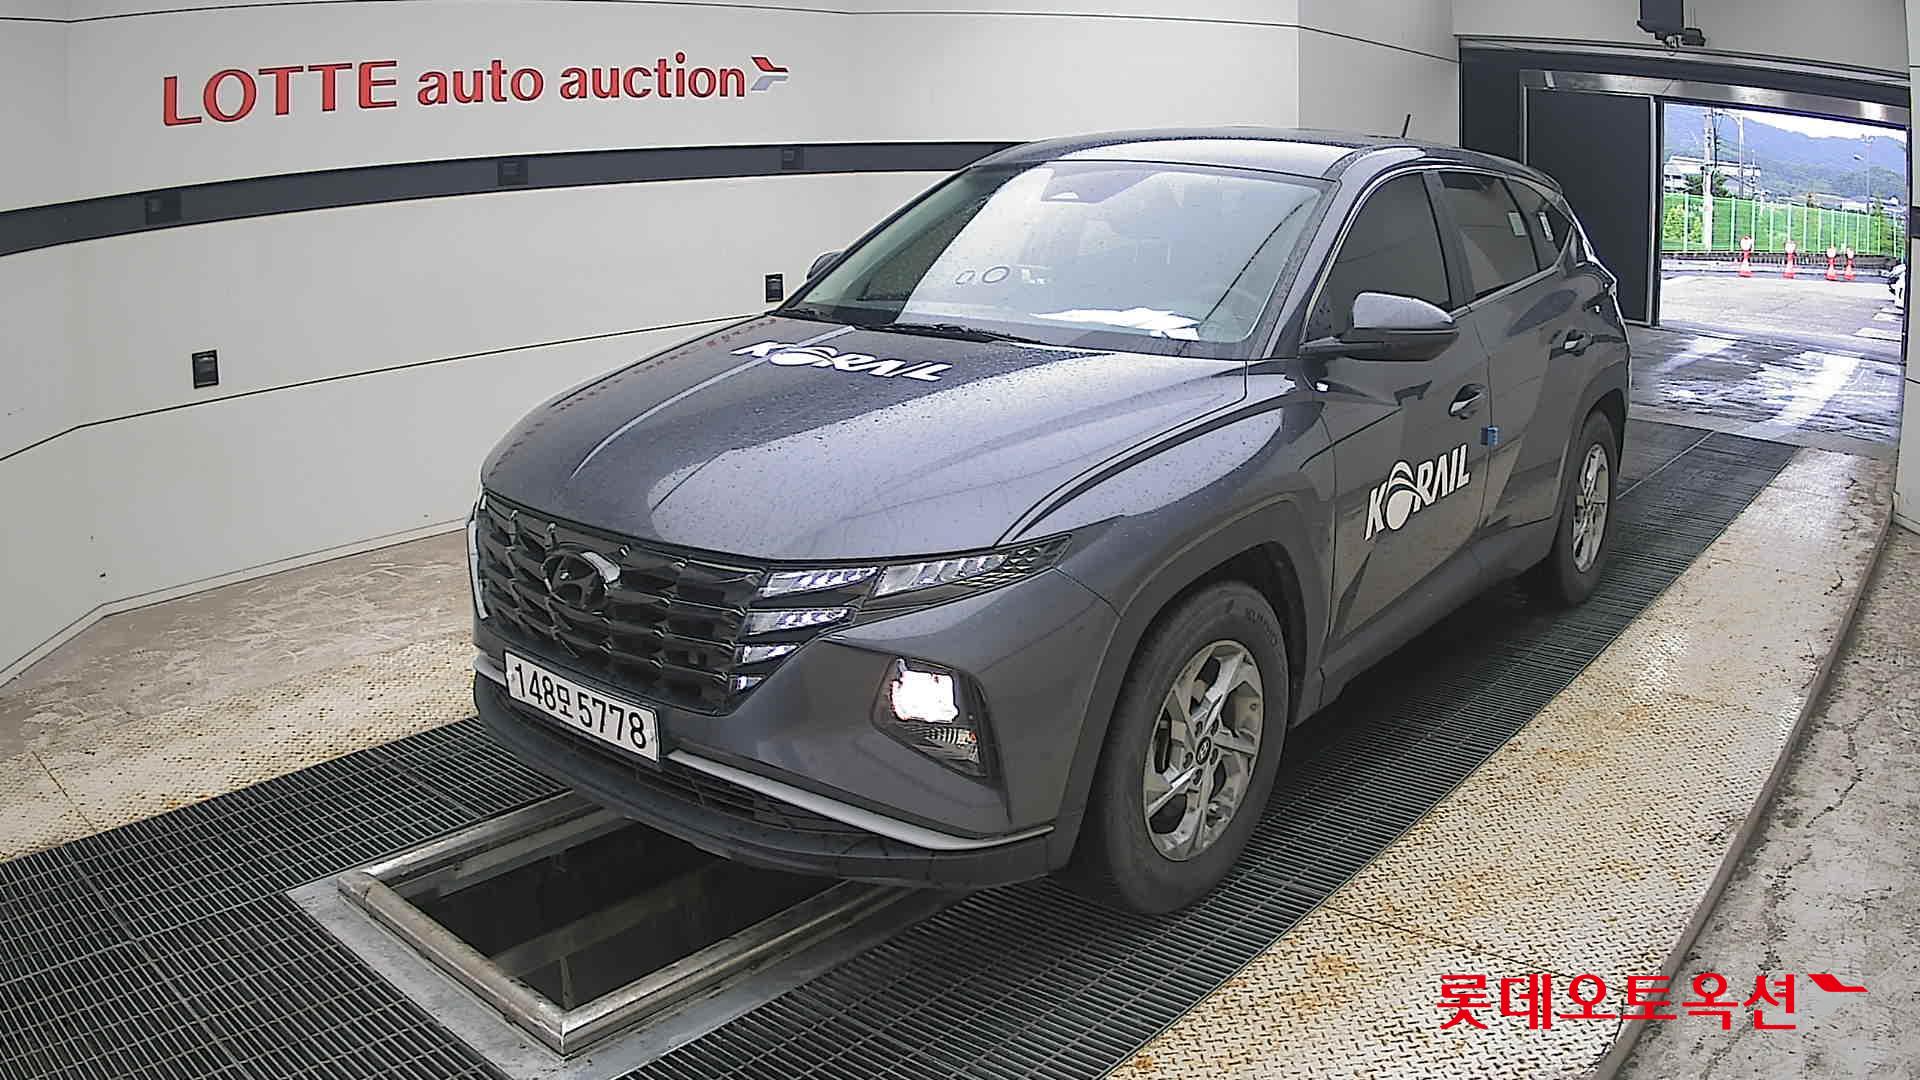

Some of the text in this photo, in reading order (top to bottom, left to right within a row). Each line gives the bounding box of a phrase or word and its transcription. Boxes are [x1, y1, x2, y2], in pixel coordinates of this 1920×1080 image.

[163, 51, 746, 127] LOTTE auto auction
[730, 340, 952, 382] KORAIL
[1364, 443, 1471, 541] KORAIL
